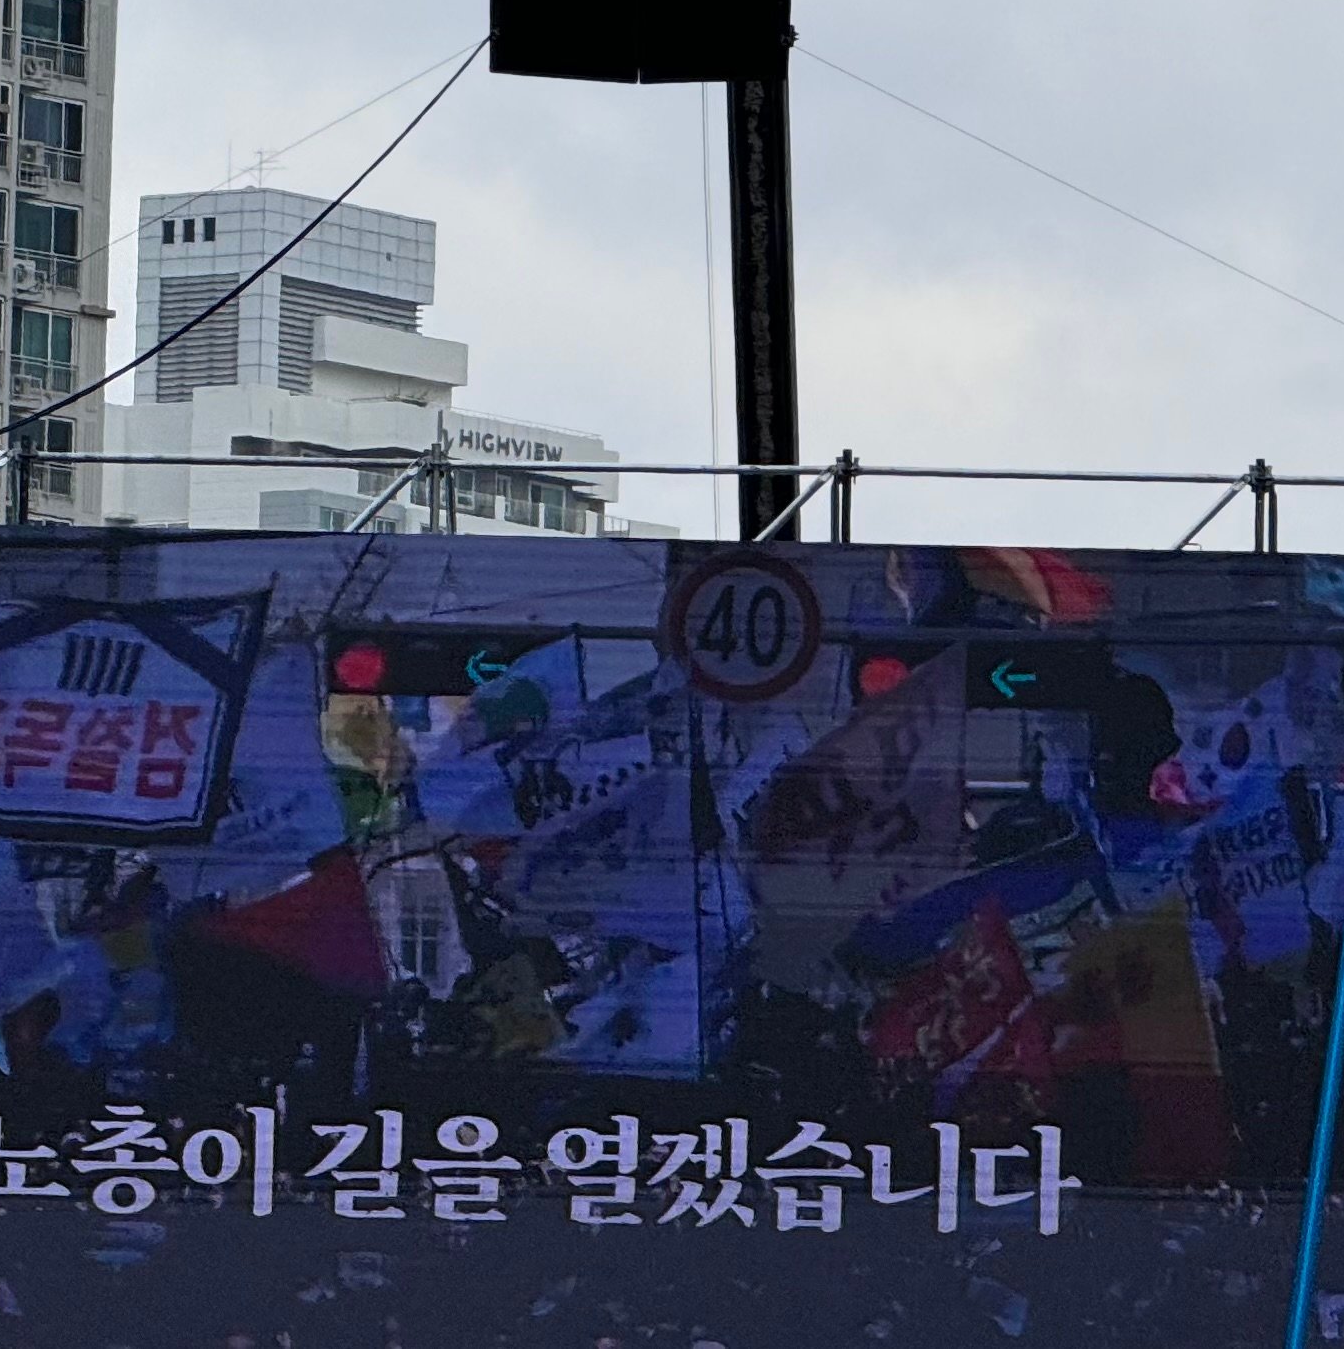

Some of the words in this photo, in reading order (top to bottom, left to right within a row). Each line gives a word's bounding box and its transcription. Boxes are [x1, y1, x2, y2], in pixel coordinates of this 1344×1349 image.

[459, 428, 563, 462] HIGHVIEW
[696, 584, 788, 668] 40
[304, 1109, 523, 1222] 길을
[546, 1114, 1083, 1236] 열겠습니다
